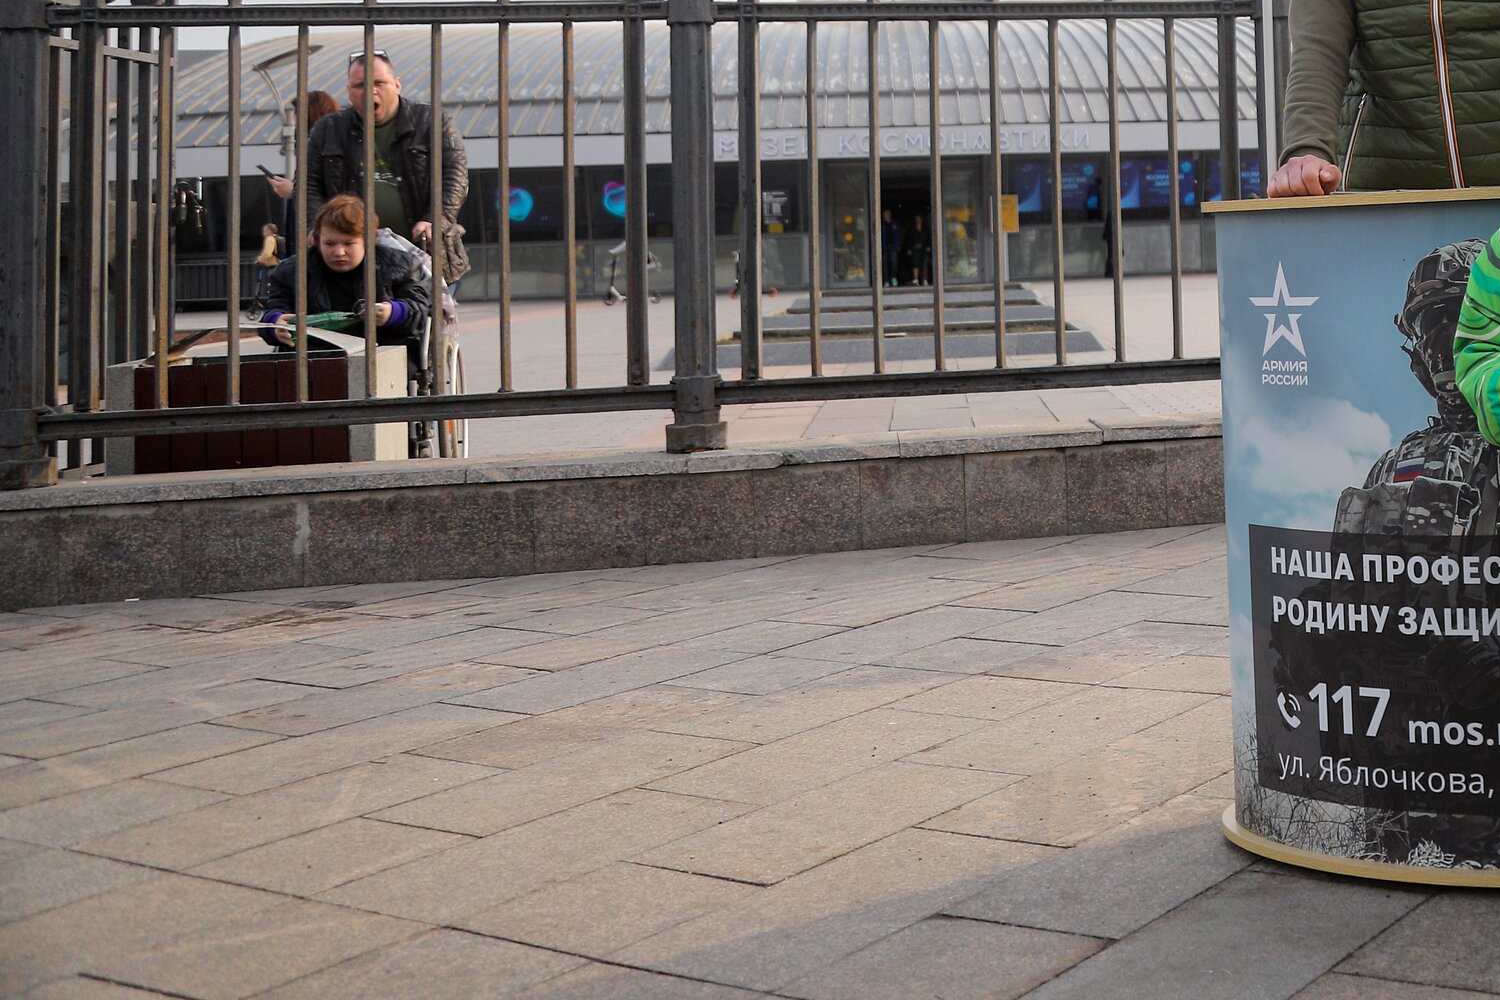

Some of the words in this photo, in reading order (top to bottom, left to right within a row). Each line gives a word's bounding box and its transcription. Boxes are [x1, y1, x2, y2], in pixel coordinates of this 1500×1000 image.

[719, 134, 808, 158] МЗЕ
[1262, 360, 1308, 372] АРМИЯ
[1262, 374, 1308, 386] РОССИИ
[1270, 546, 1355, 581] НАША
[1272, 595, 1390, 635] РОДИНУ
[1308, 682, 1391, 737] 117
[1278, 752, 1310, 780] ул.
[1318, 755, 1494, 799] Яблочкова,
